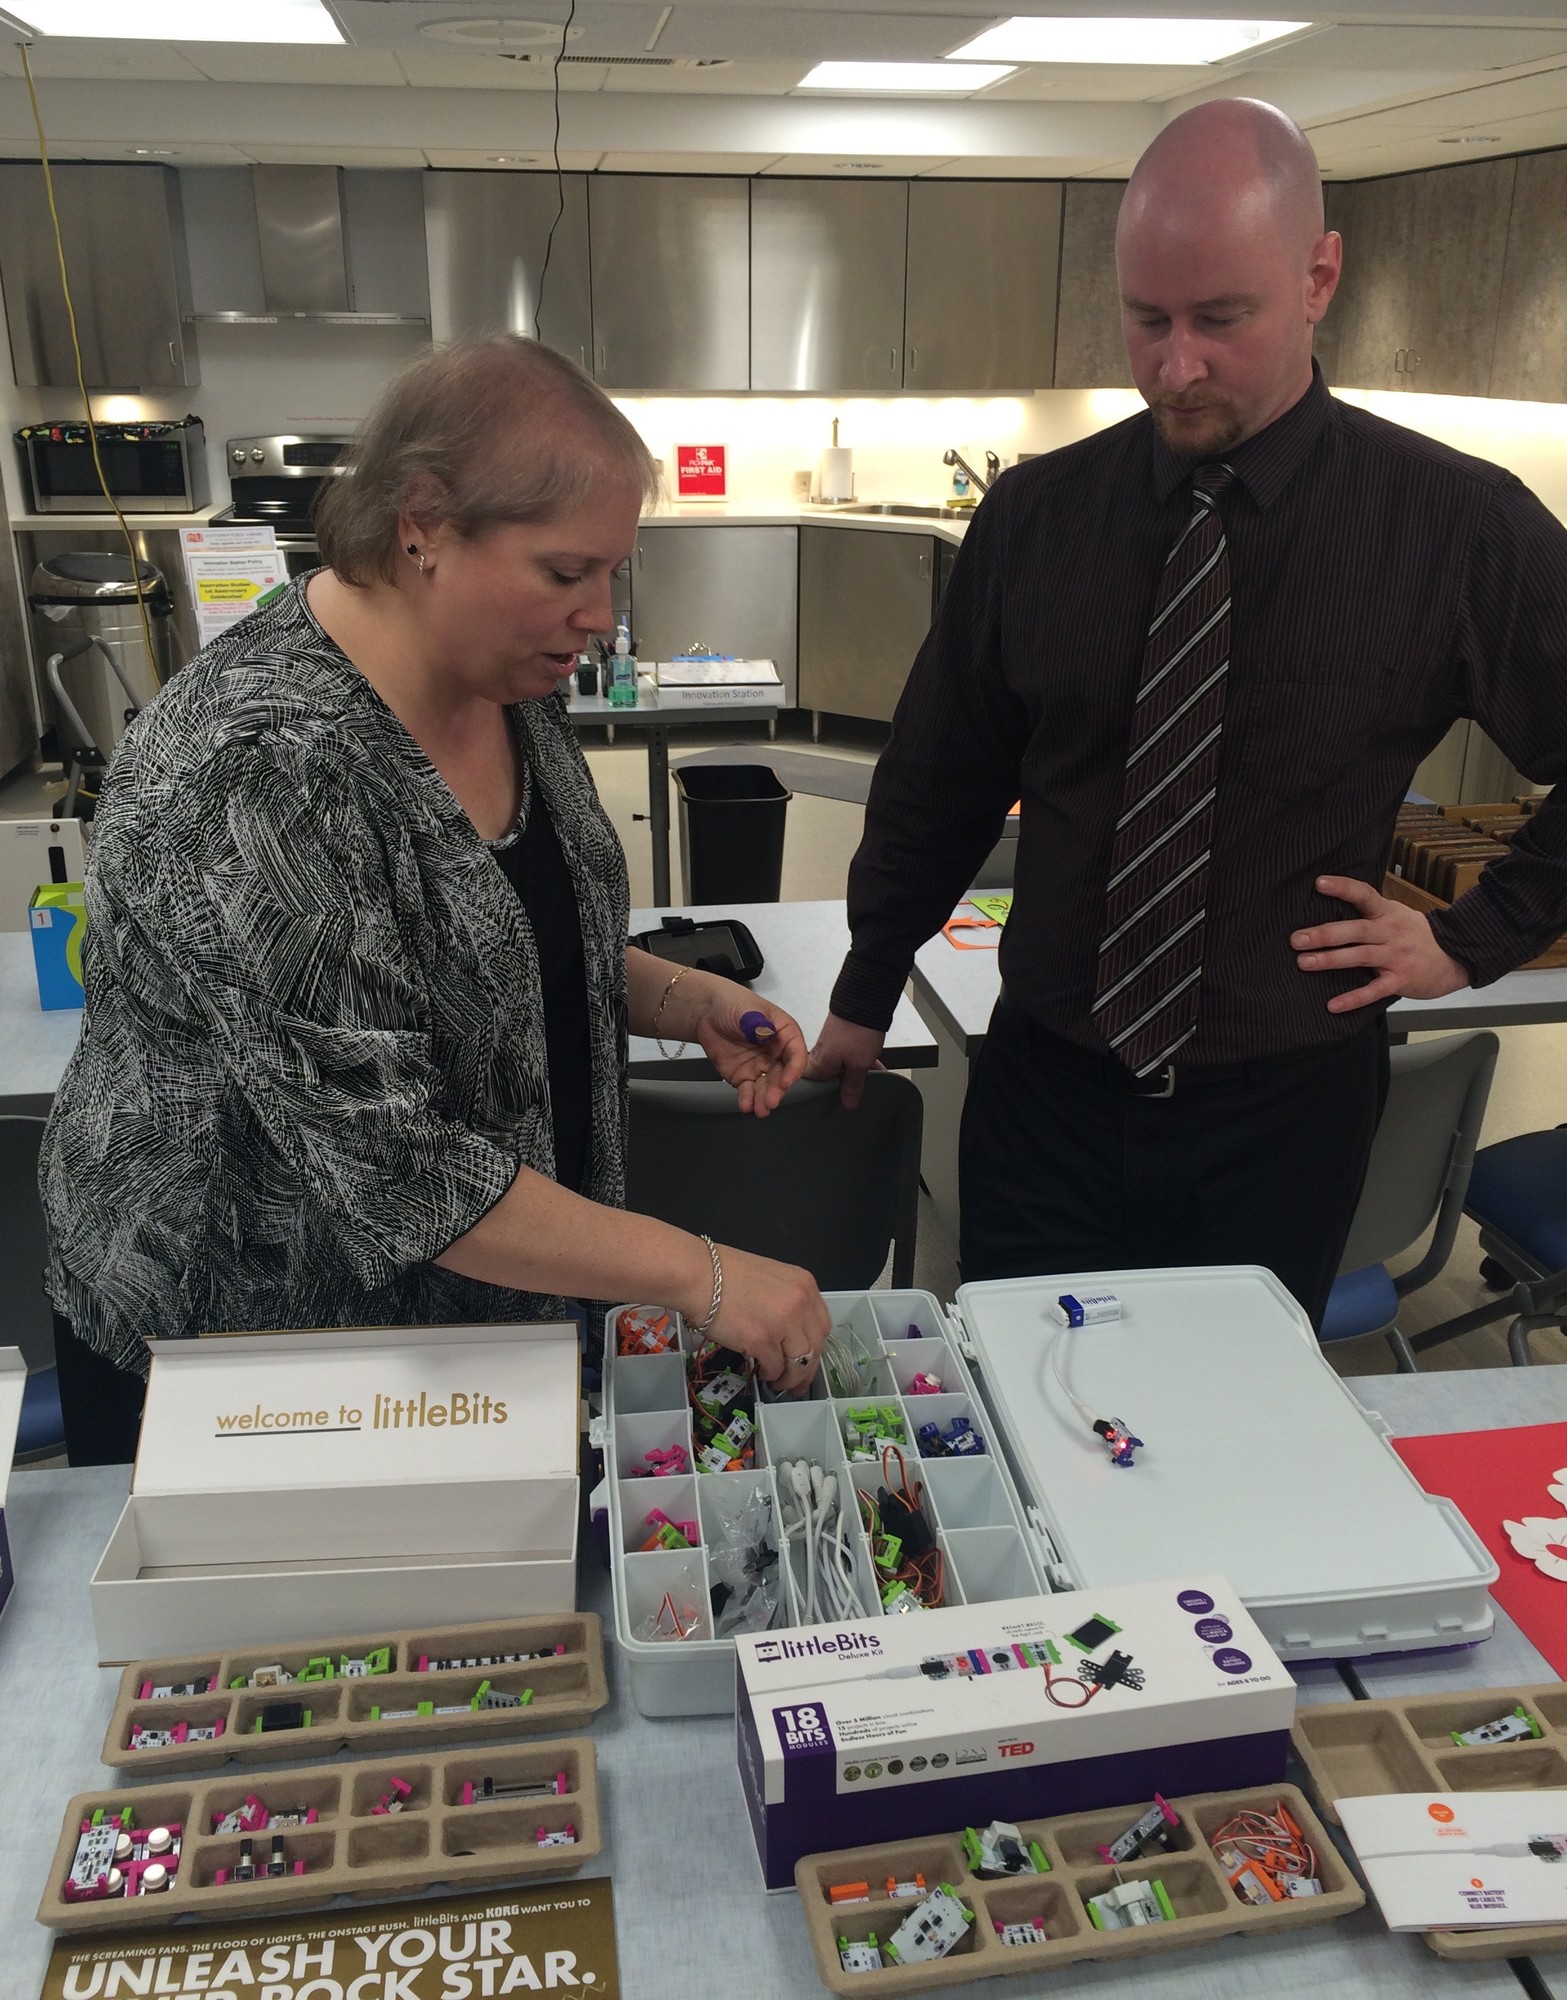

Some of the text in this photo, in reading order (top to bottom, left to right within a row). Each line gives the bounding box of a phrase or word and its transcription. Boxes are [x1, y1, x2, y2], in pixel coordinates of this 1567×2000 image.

[682, 690, 764, 699] Innovation Station
[37, 913, 44, 926] 1
[216, 1391, 509, 1430] welcome to littleBits
[781, 1632, 880, 1659] littleBits
[838, 1649, 884, 1661] Deluxe Kit
[780, 1707, 821, 1732] 18
[785, 1728, 826, 1745] BITS
[789, 1740, 829, 1750] MODULES
[840, 1735, 865, 1743] Endless
[998, 1742, 1035, 1758] TED
[71, 1898, 591, 1963] THE SCREAMING FANS. THE FLOOD OF LIGHTS. THE ONSTAGE RUSH. littleBits AND KORG WANT YOU TO
[62, 1919, 515, 2000] UNLEASH YOUR
[440, 1950, 597, 2000] STAR.
